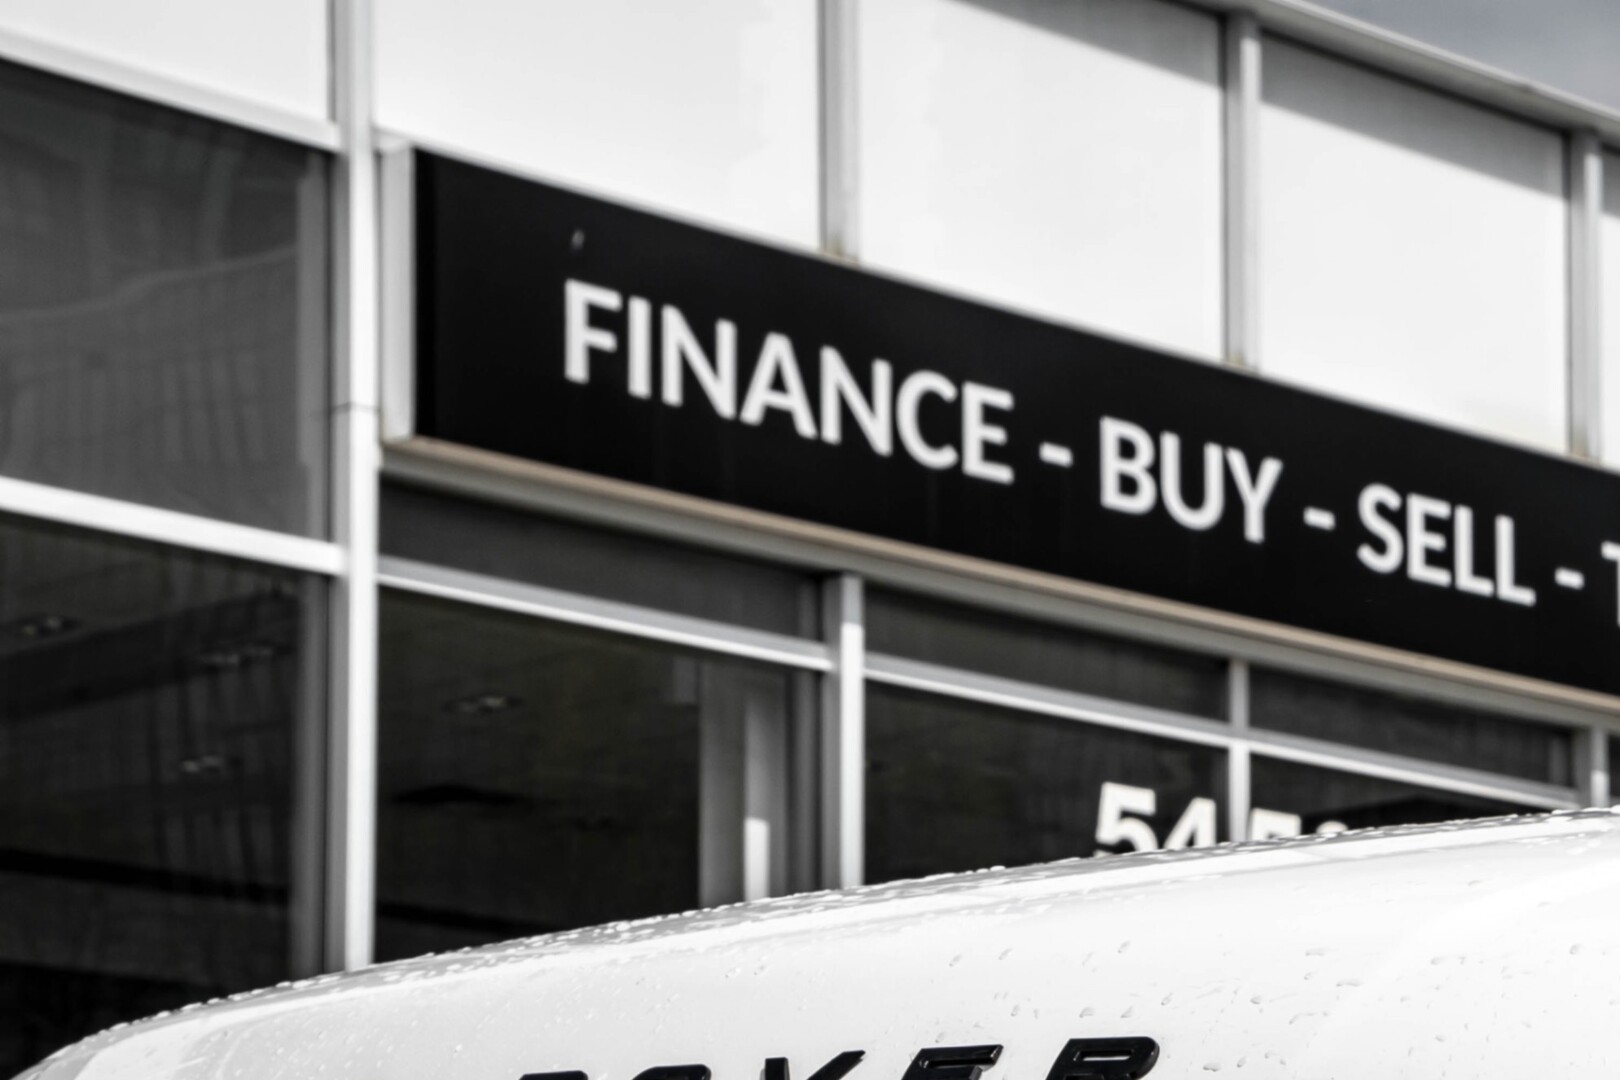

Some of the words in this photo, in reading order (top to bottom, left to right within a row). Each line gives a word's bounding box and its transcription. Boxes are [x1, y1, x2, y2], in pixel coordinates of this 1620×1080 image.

[565, 280, 1013, 483] FINANCE
[1100, 416, 1283, 543] BUY
[1357, 483, 1536, 605] SELL
